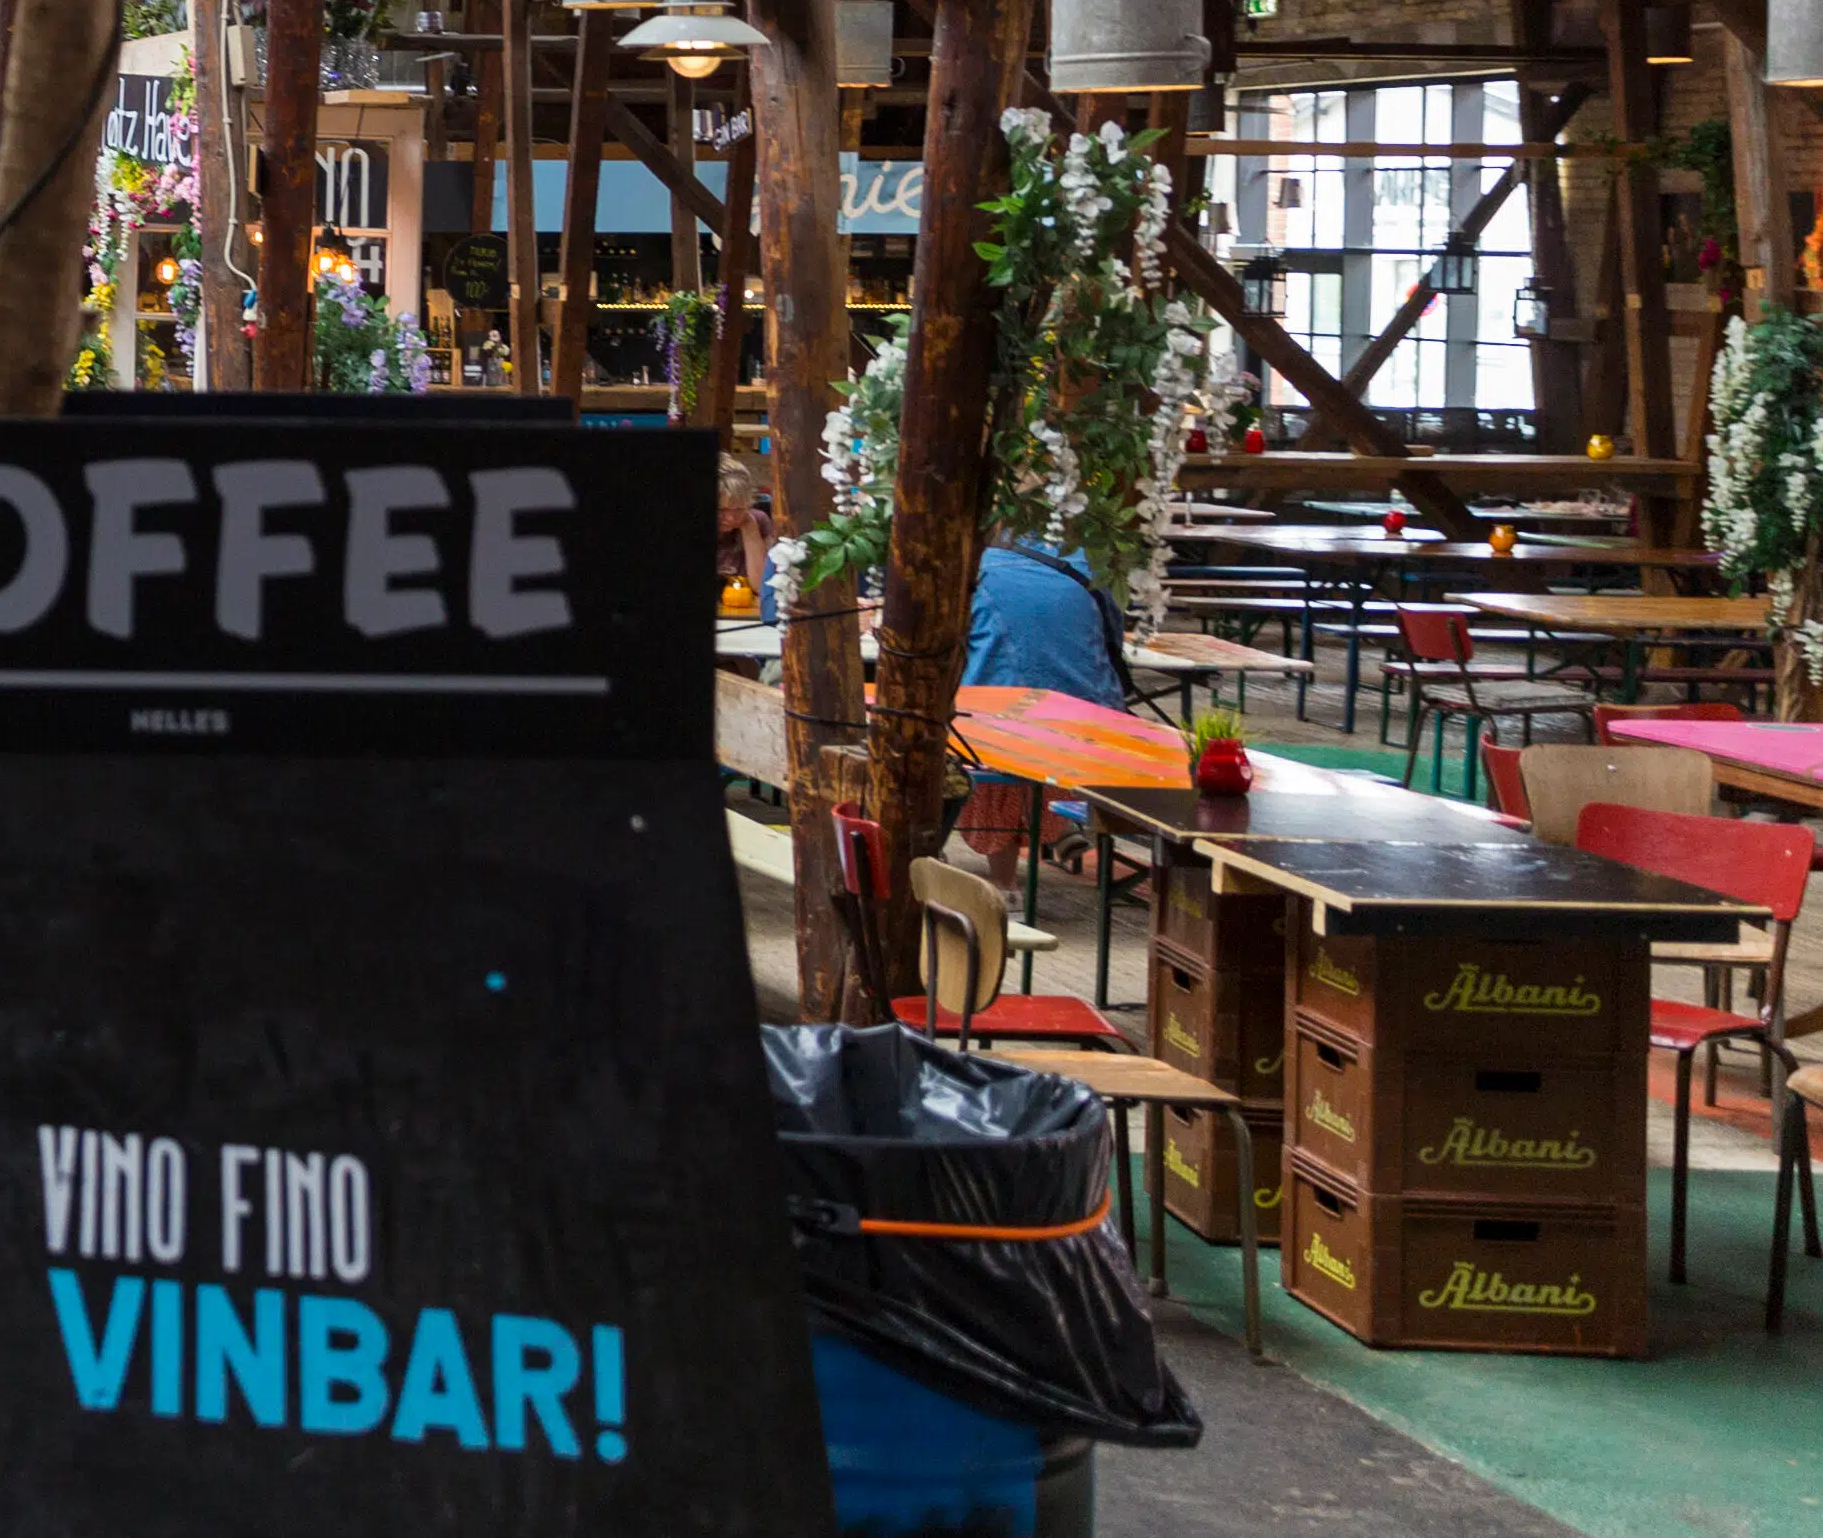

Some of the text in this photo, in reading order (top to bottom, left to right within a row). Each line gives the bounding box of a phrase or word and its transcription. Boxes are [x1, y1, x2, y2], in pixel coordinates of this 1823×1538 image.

[1423, 964, 1602, 1016] Albani
[1419, 1117, 1597, 1169] Albani
[38, 1124, 372, 1284] VINO FINO
[1419, 1263, 1597, 1316] Albani
[46, 1266, 629, 1464] VINBAR!
